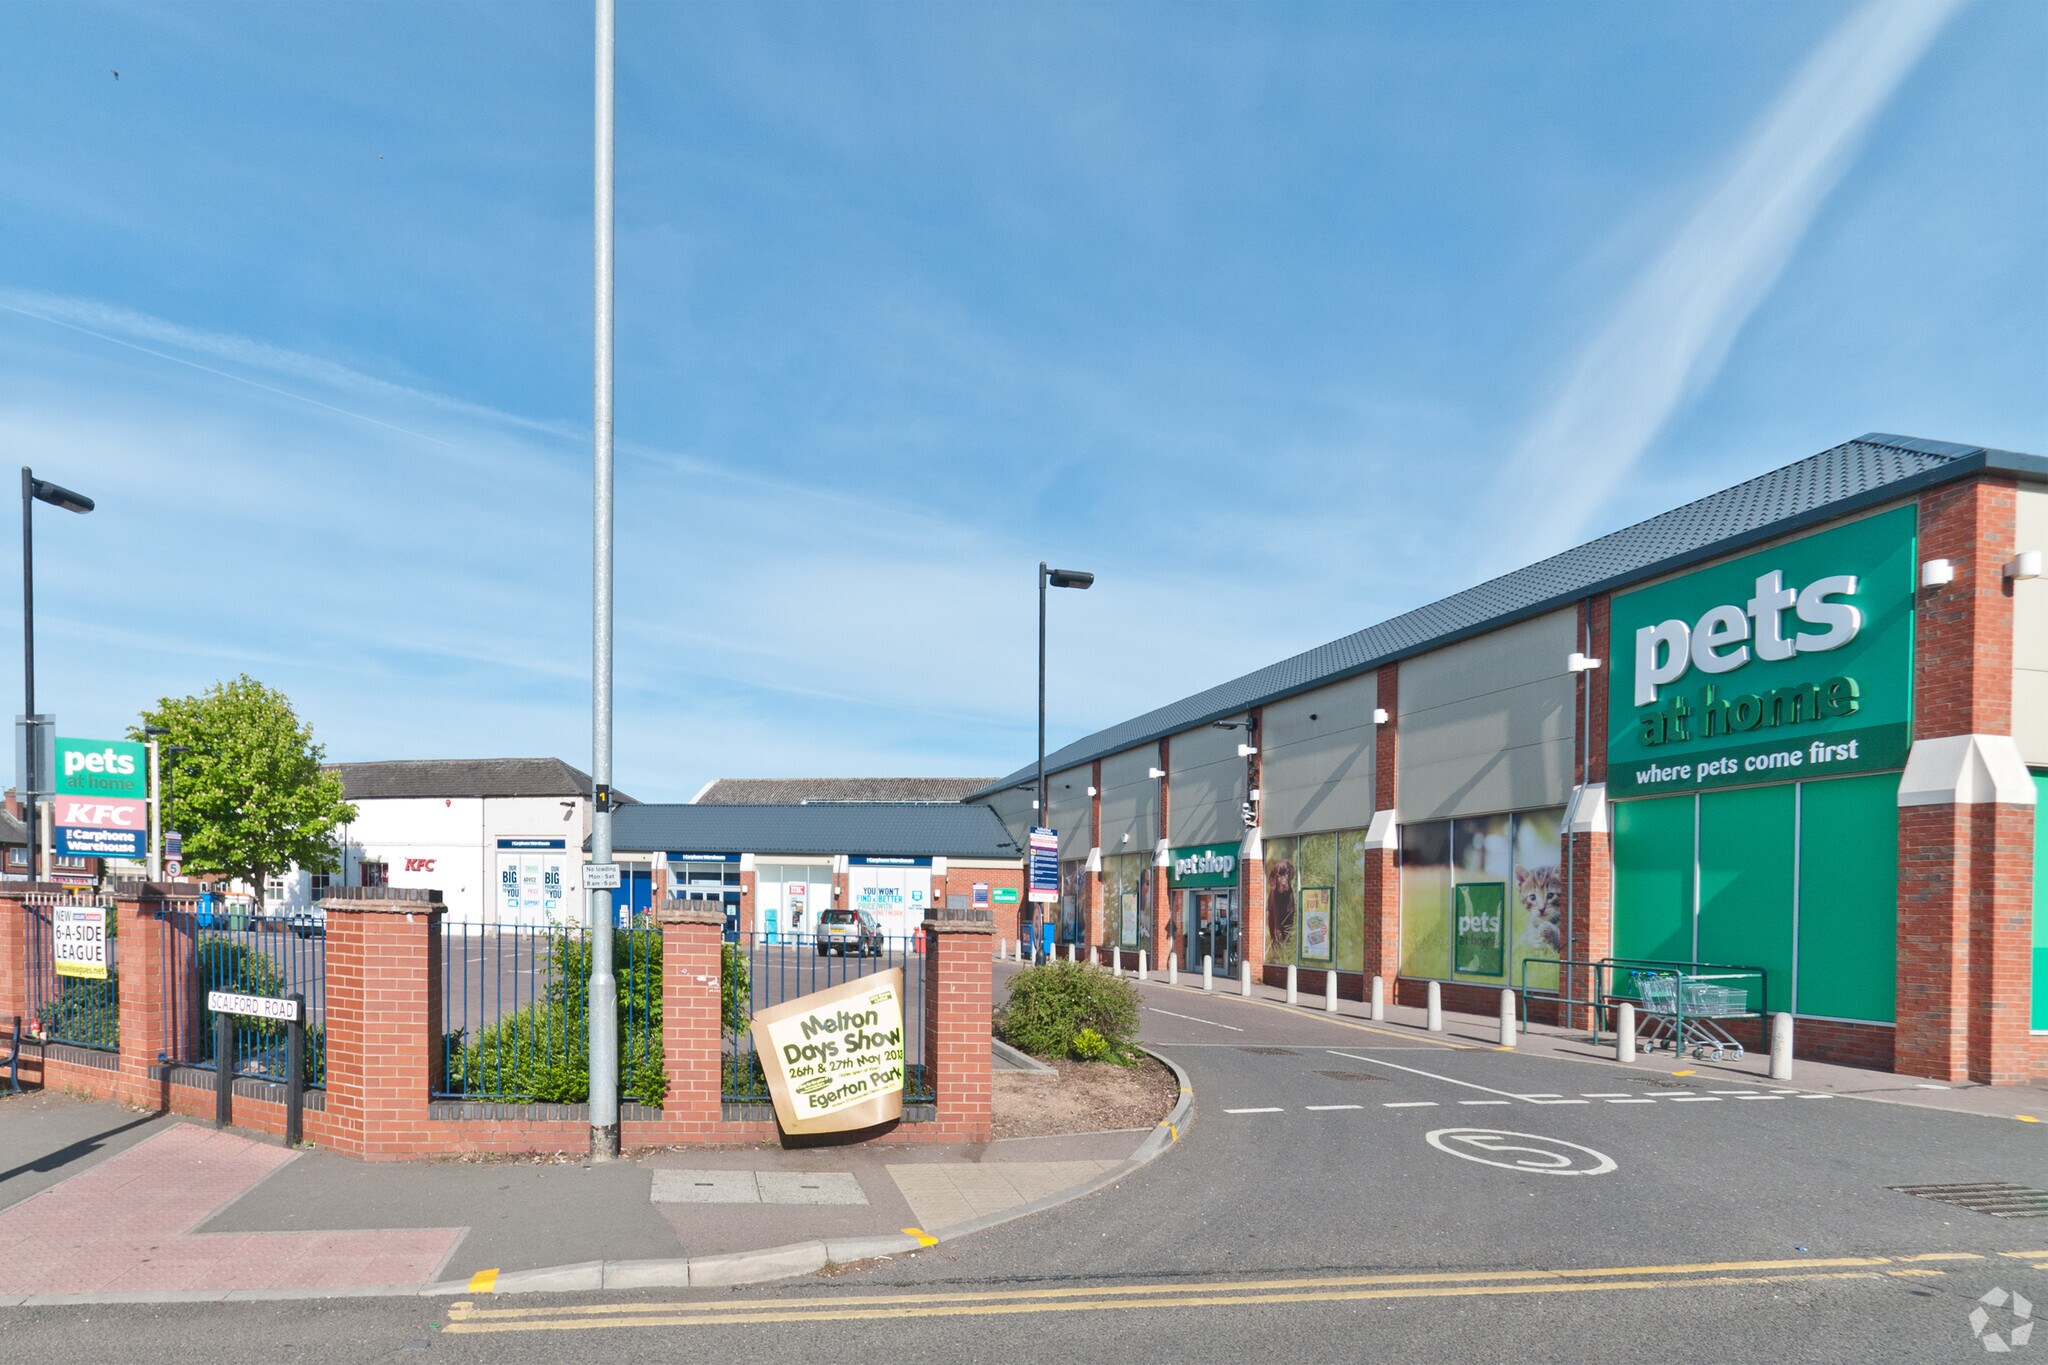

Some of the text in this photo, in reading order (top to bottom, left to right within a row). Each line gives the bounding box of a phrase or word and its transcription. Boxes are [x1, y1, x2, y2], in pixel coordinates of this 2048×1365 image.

[1634, 569, 1863, 707] pets
[1637, 676, 1860, 747] at home
[64, 748, 135, 776] pets
[1636, 739, 1859, 785] where pets come first
[66, 774, 135, 791] at home
[599, 792, 606, 802] 1
[64, 803, 135, 826] KFC
[72, 829, 135, 842] Carphone
[67, 841, 135, 852] Warehouse
[170, 864, 177, 874] 5
[405, 858, 435, 872] KFC
[502, 871, 517, 883] BIG
[545, 872, 559, 884] BIG
[507, 889, 519, 897] YOU
[549, 890, 562, 898] YOU
[863, 887, 876, 895] YOU
[878, 895, 903, 903] BETTER
[56, 910, 72, 921] NEW
[1459, 911, 1500, 936] pets
[56, 925, 102, 941] 6-A-SIDE
[56, 944, 102, 961] LEAGUE
[211, 994, 293, 1018] SCALFORD ROAD
[800, 1010, 878, 1040] Melton
[783, 1027, 901, 1065] Days Show
[789, 1065, 814, 1079] 26th
[817, 1063, 827, 1074] &
[829, 1058, 853, 1071] 27th
[857, 1054, 881, 1066] May
[808, 1080, 867, 1108] Egerton
[870, 1066, 902, 1087] Park
[1450, 1135, 1572, 1167] 5
